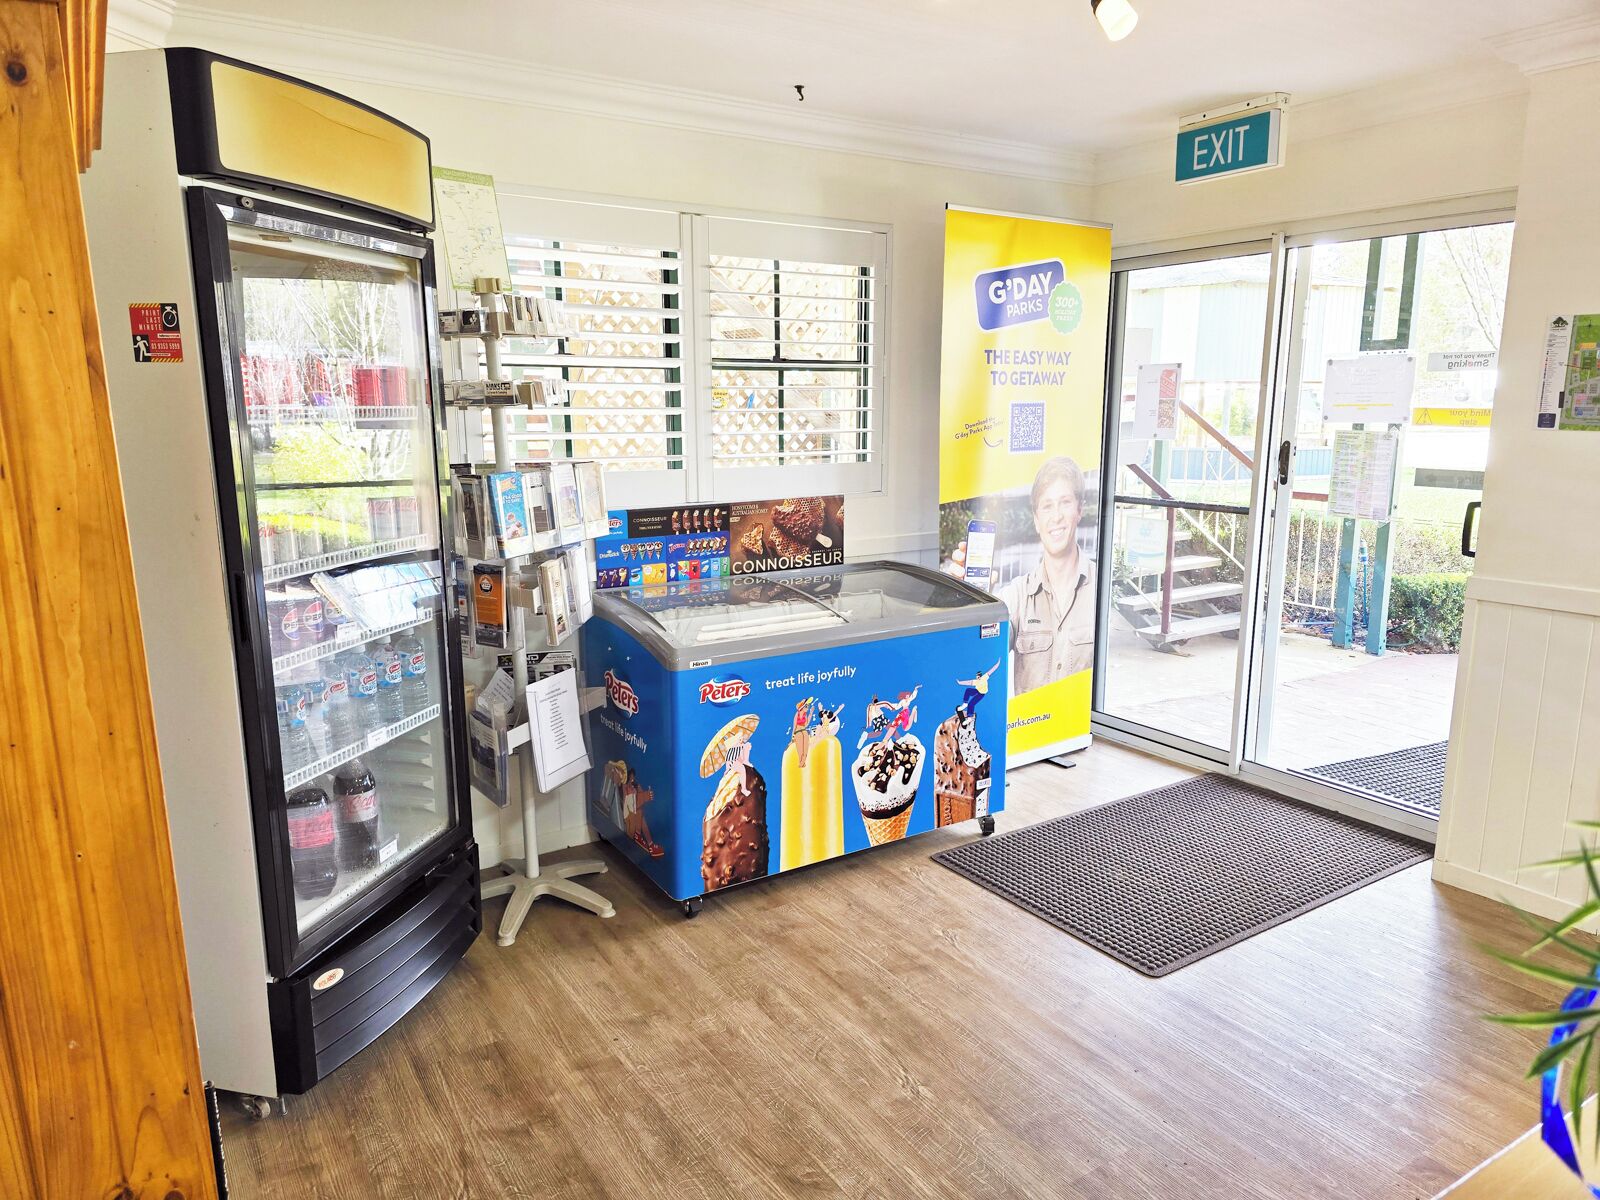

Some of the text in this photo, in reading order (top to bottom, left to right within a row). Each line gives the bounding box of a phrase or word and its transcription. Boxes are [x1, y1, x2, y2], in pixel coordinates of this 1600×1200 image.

[1193, 124, 1251, 171] EXIT
[988, 271, 1053, 304] G'DAY
[141, 309, 160, 317] PRINT
[1006, 299, 1043, 318] PARKS
[145, 316, 161, 324] LAST
[984, 350, 1072, 366] THE EASY WAY
[991, 371, 1067, 386] TO GETAWAY
[964, 417, 989, 430] Download
[732, 551, 843, 575] CONNOISSEUR
[692, 659, 709, 668] Hiron
[765, 665, 857, 690] treat life joyfully
[604, 670, 639, 714] Peters
[699, 680, 752, 704] Peters
[600, 713, 647, 753] treat life joyfully
